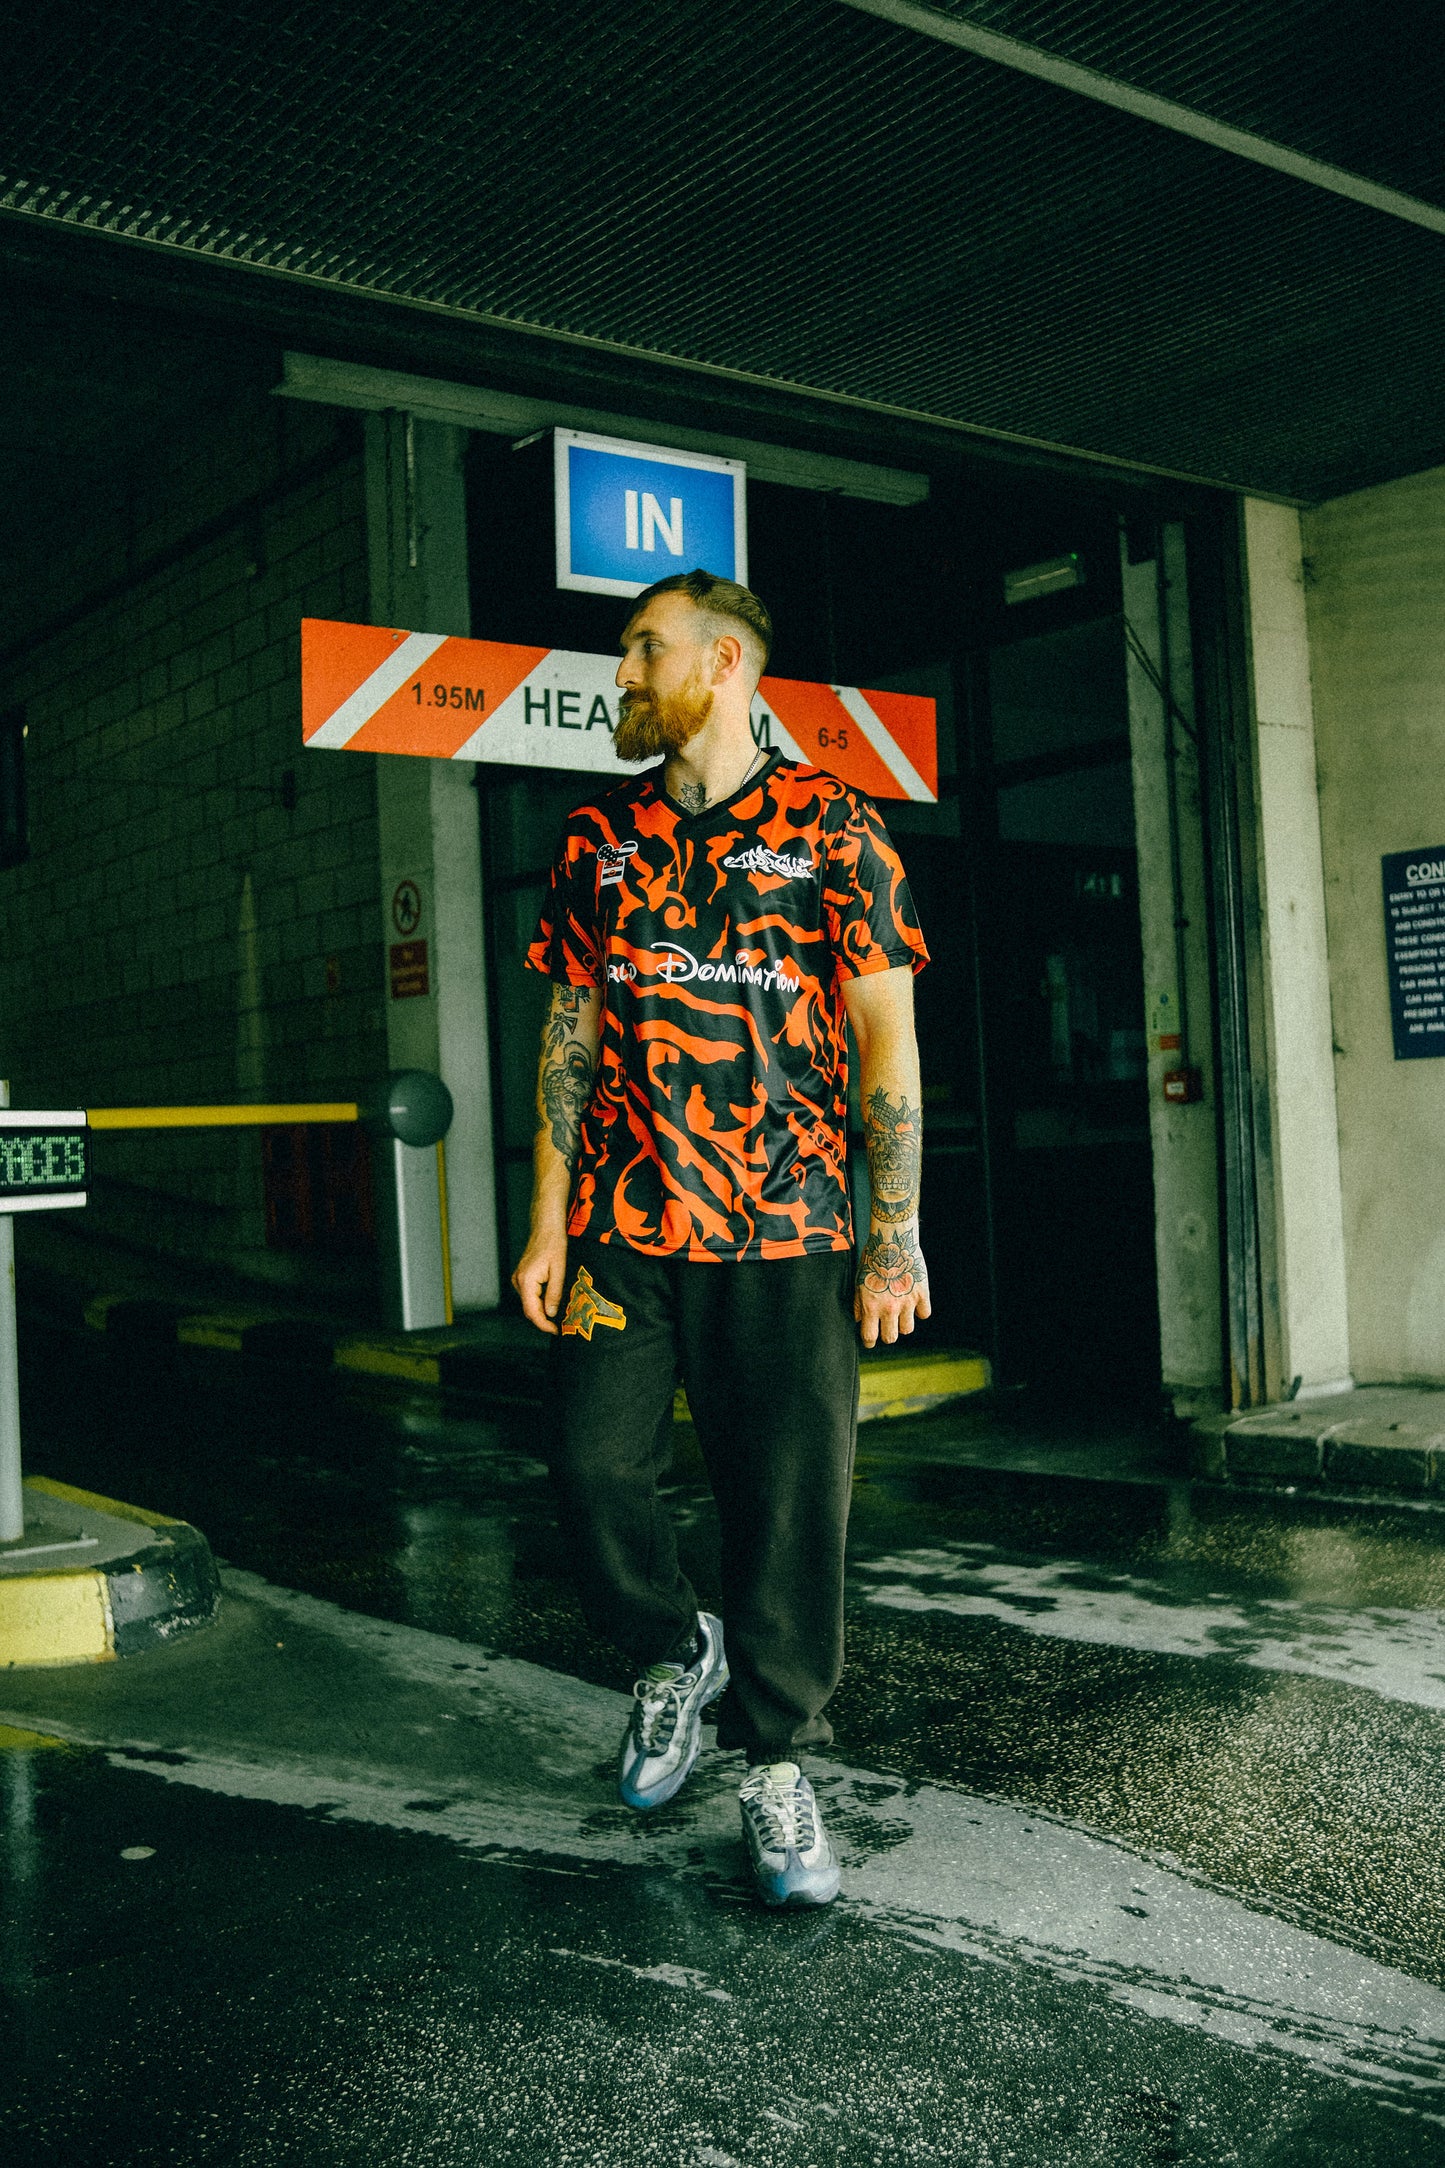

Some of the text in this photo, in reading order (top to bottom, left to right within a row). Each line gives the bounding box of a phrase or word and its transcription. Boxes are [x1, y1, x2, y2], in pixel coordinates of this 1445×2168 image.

[625, 489, 684, 556] IN
[411, 681, 485, 712] 1.95M
[818, 727, 848, 750] 6-5
[1406, 861, 1445, 881] CON
[607, 963, 637, 983] RLD
